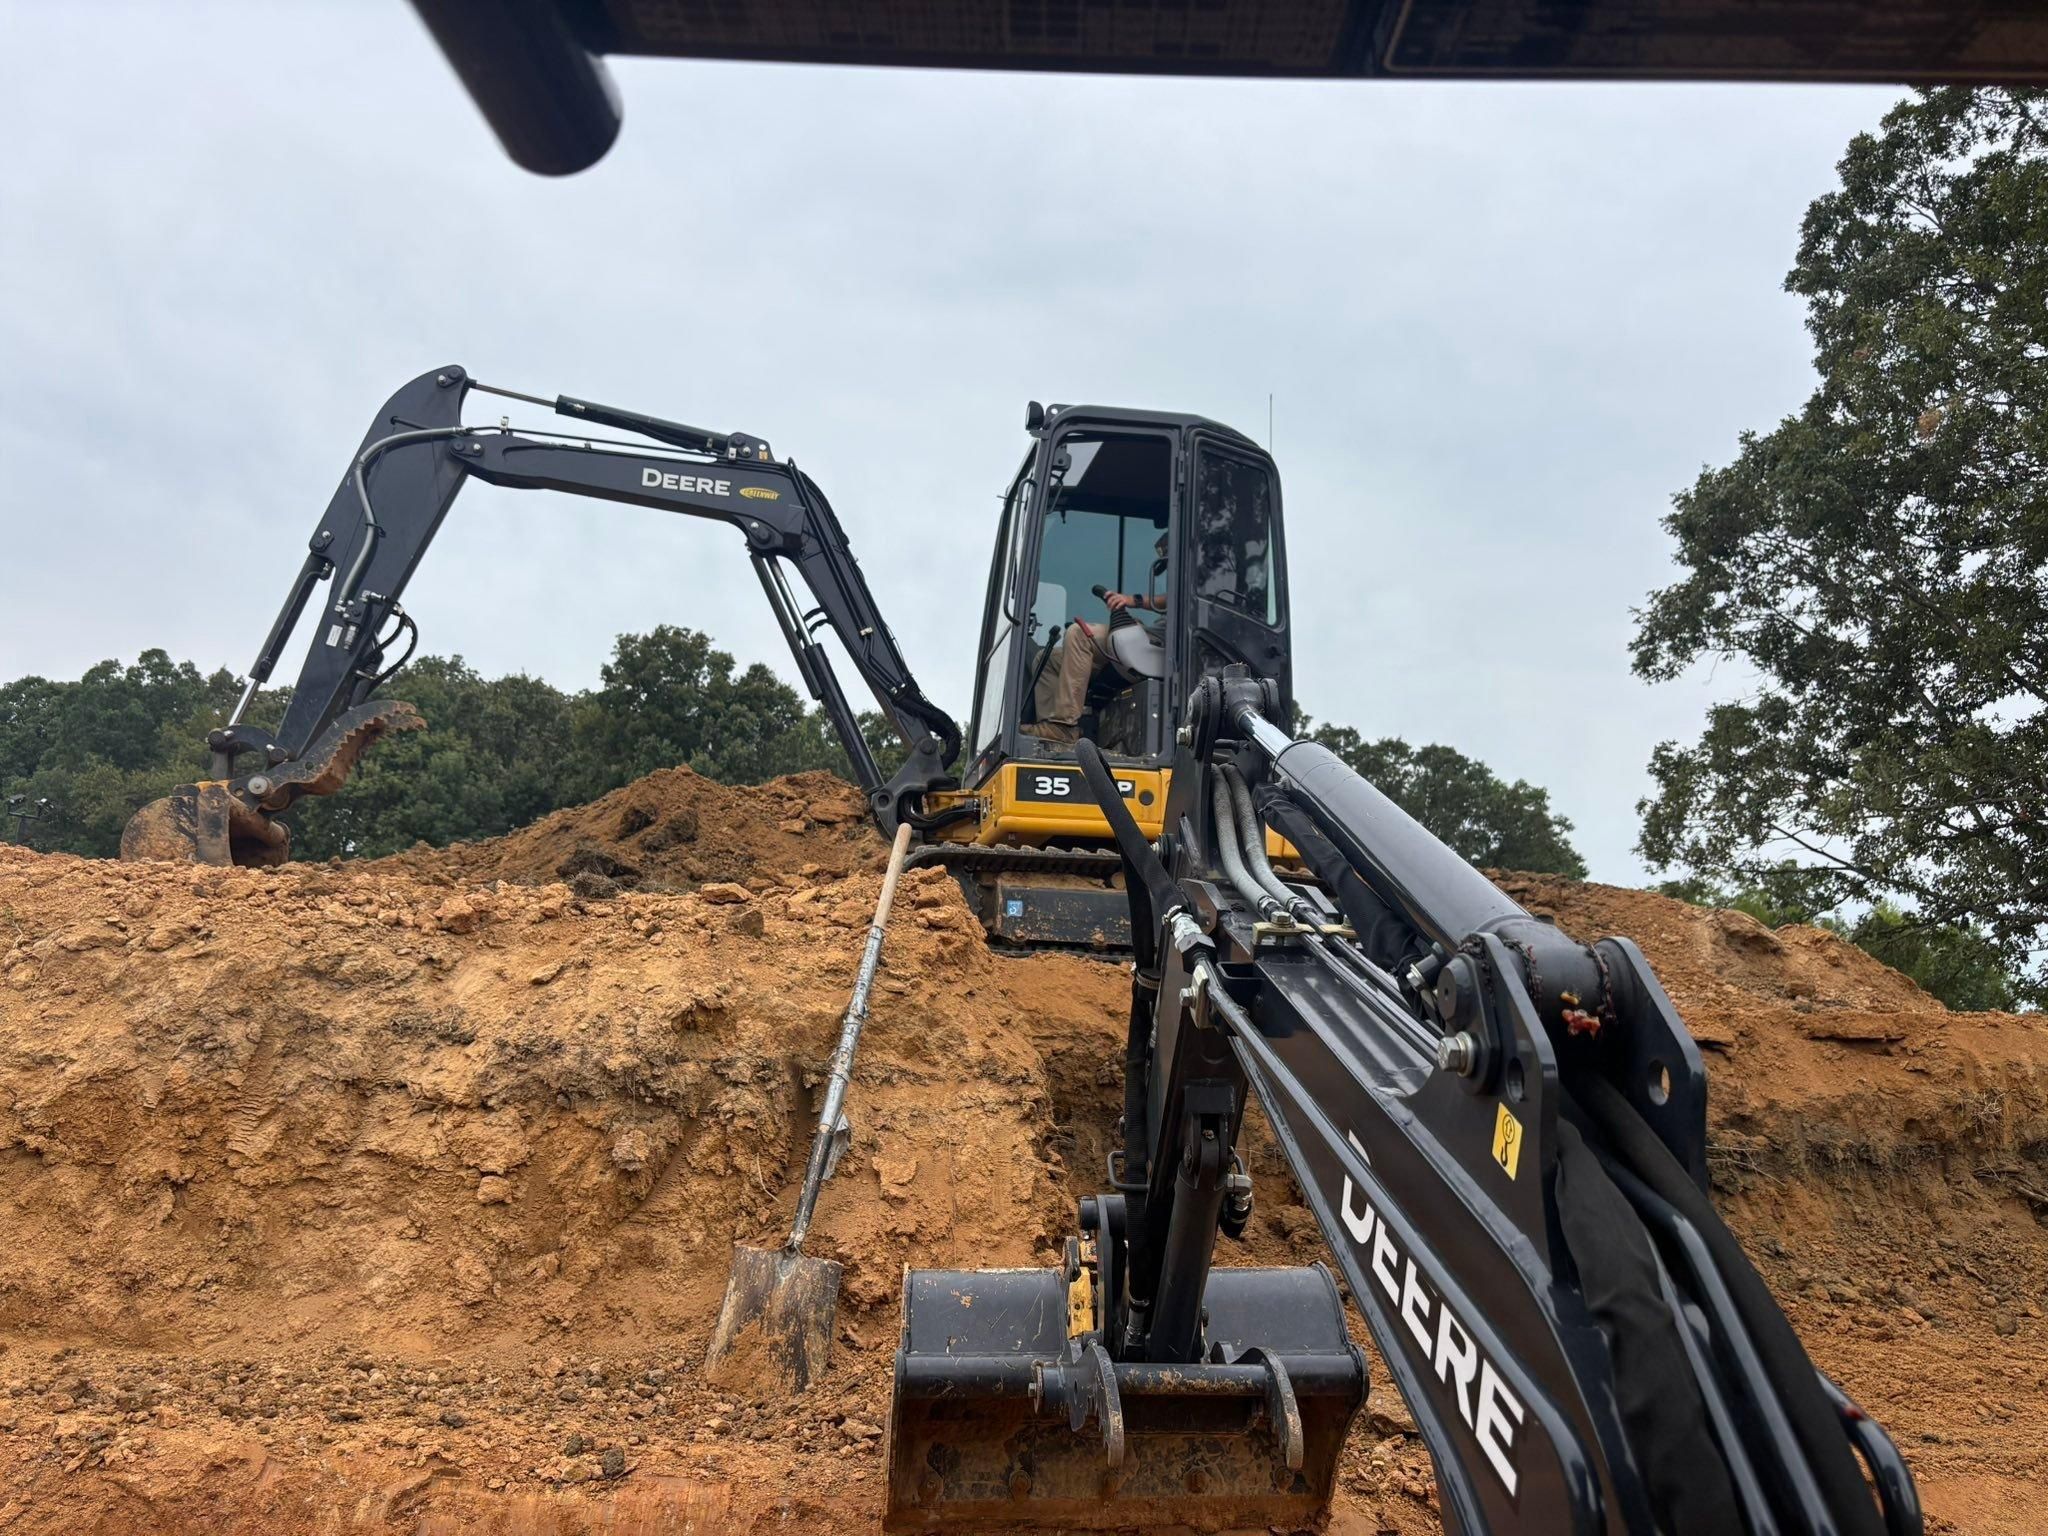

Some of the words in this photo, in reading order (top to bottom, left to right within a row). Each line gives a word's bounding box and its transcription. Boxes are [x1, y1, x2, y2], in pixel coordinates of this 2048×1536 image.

[641, 467, 731, 497] DEERE
[1035, 776, 1071, 796] 35
[1341, 1129, 1525, 1497] DEERE
